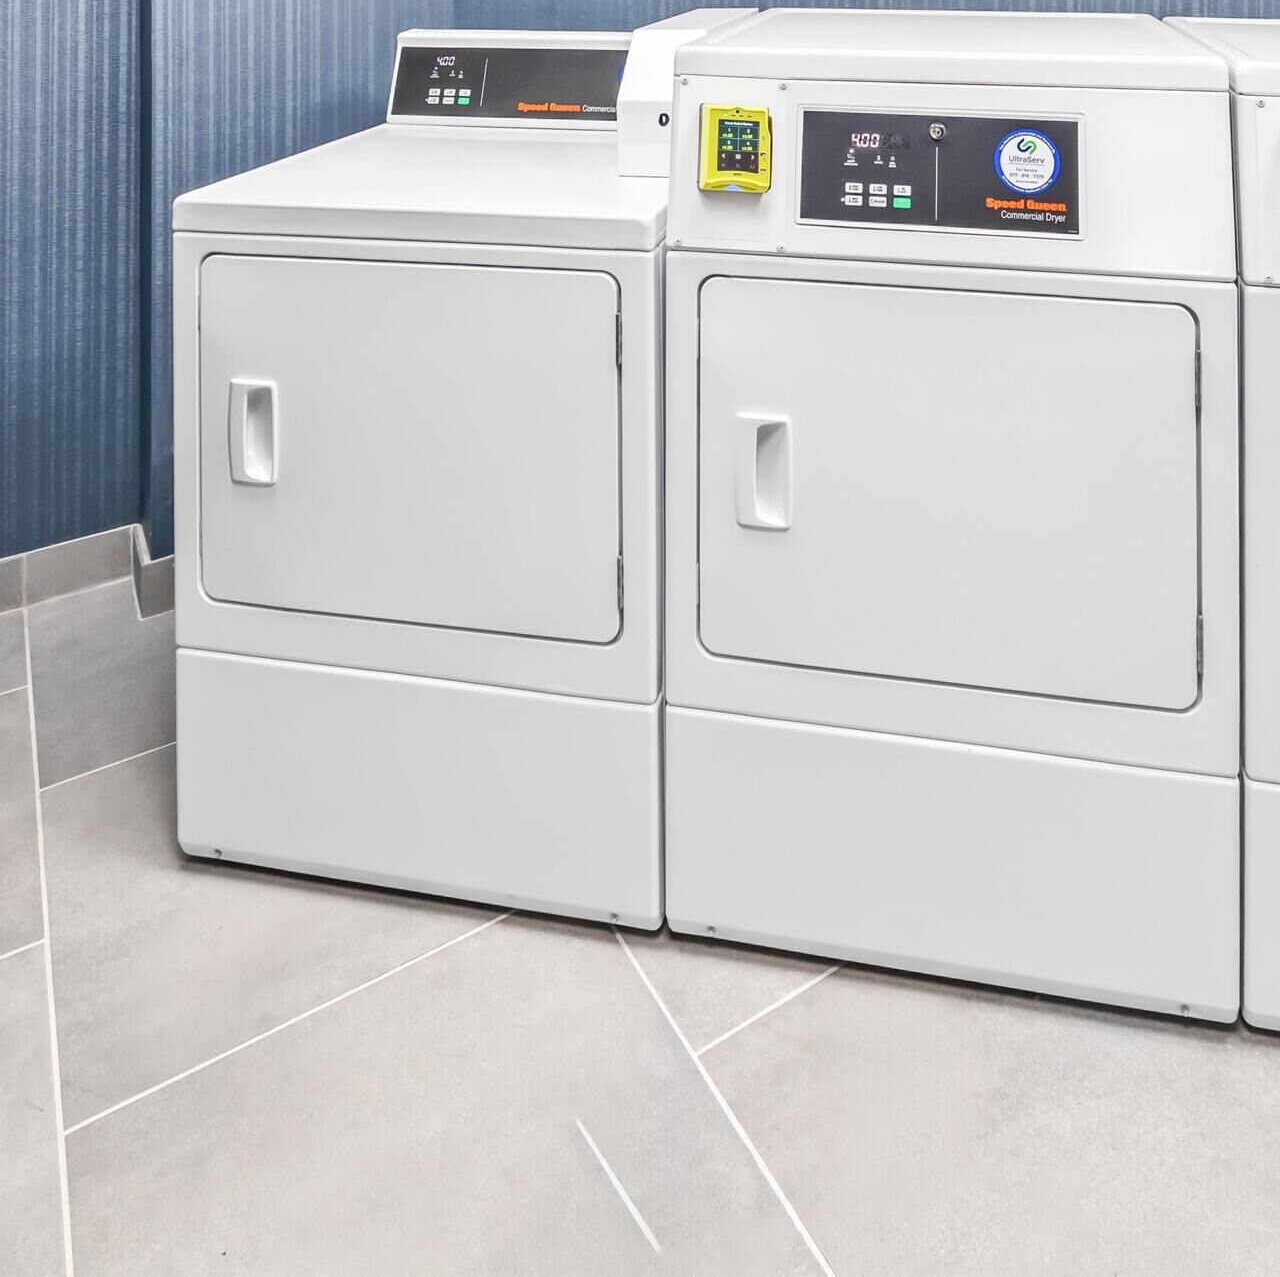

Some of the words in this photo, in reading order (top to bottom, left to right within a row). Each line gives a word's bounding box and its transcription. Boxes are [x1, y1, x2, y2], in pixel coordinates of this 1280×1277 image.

[518, 102, 548, 112] Speed
[549, 103, 581, 112] Queen
[582, 105, 617, 113] Commercia
[1008, 155, 1045, 164] UltraServ
[985, 197, 1025, 209] Speed
[1026, 199, 1067, 211] Queen
[1000, 210, 1044, 221] Commercial
[1045, 213, 1066, 224] Dryer
